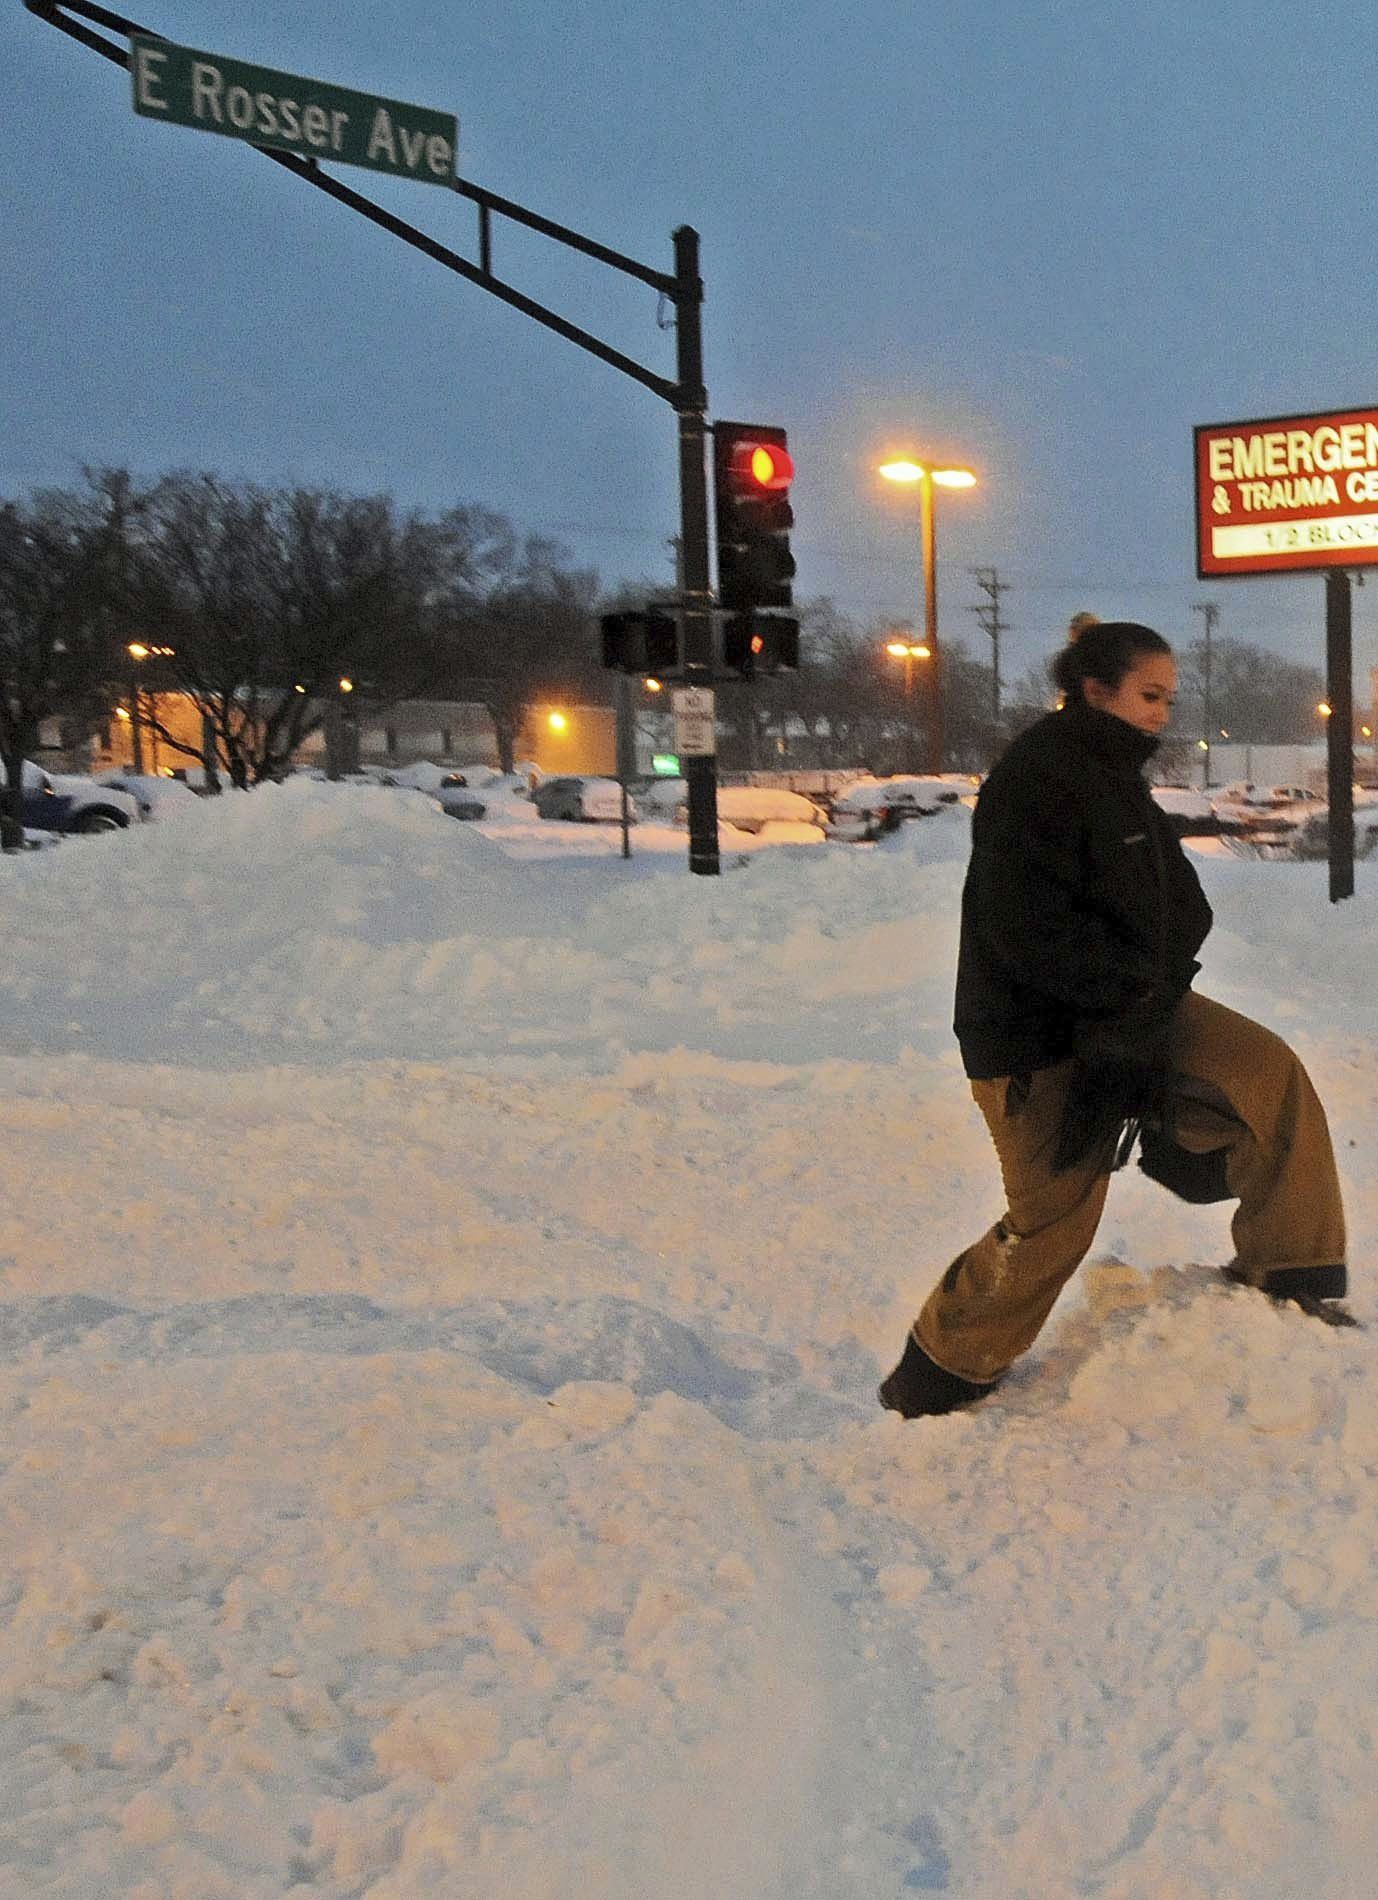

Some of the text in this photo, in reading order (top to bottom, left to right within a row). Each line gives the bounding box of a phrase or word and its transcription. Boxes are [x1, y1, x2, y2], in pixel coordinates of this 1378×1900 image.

[138, 49, 452, 175] E Rosser Ave
[1211, 485, 1231, 515] &
[1238, 475, 1340, 512] TRAUMA
